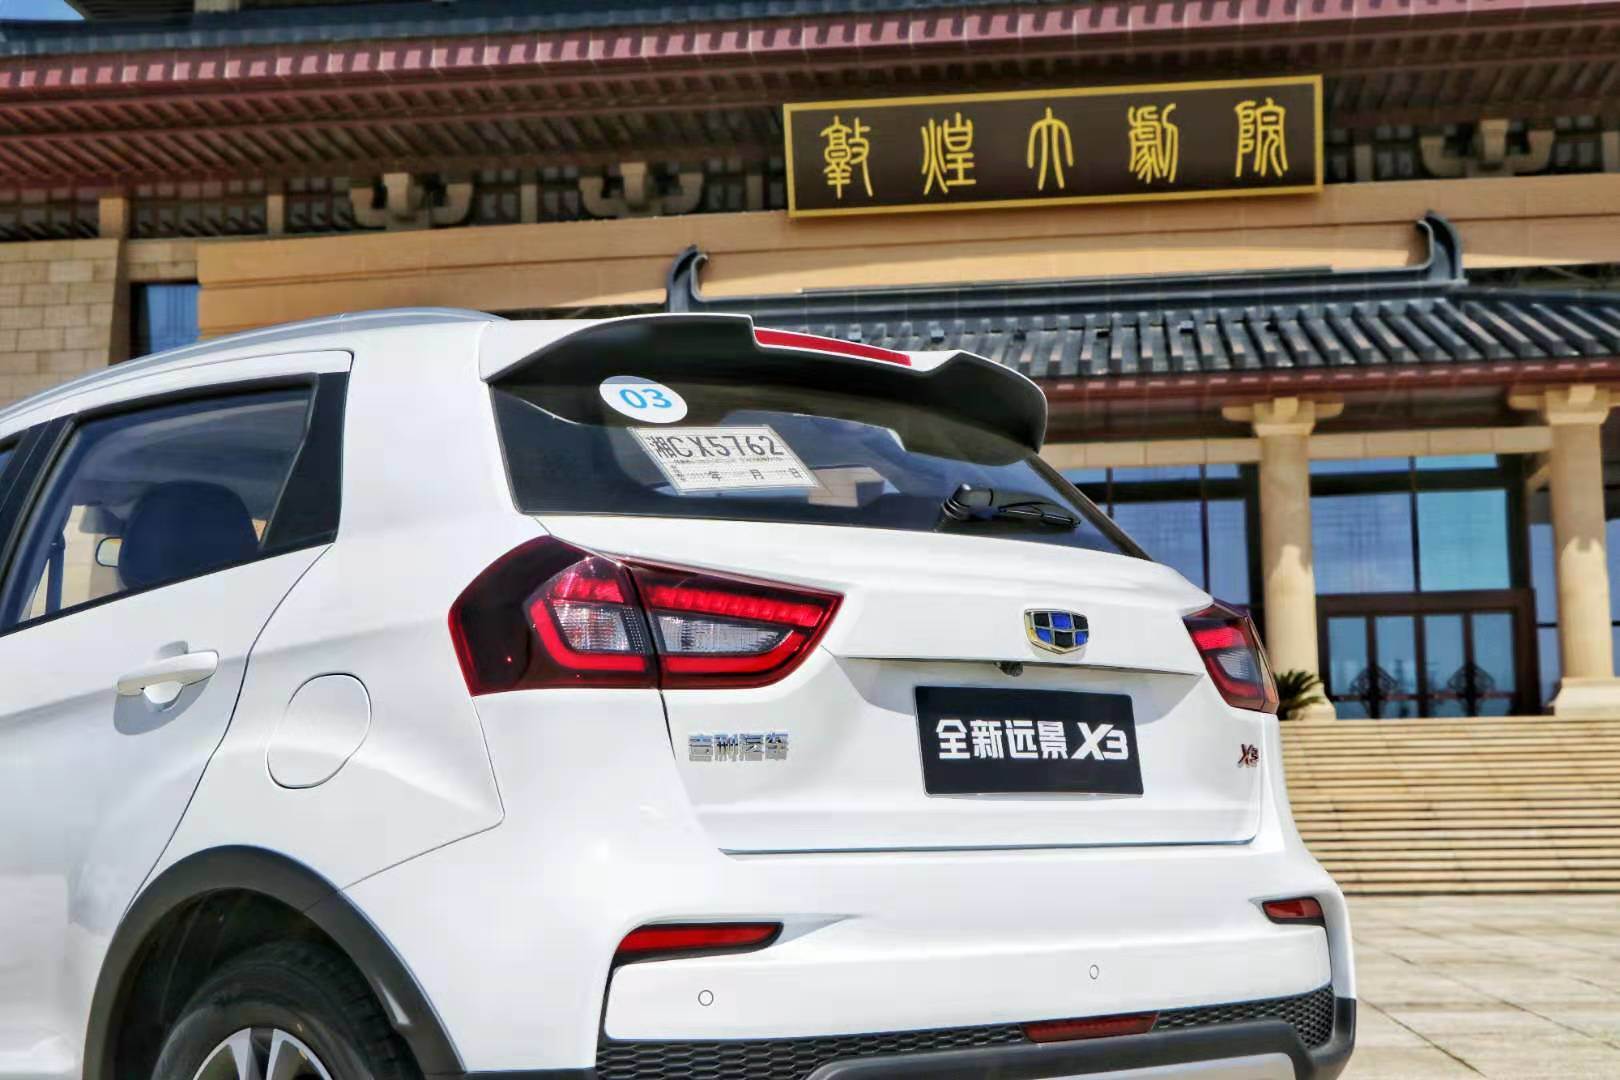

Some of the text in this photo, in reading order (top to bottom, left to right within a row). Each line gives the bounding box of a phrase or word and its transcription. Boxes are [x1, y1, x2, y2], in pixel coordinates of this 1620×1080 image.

[619, 388, 673, 409] 03
[648, 435, 785, 459] 湘CX5762
[1237, 743, 1259, 768] X3
